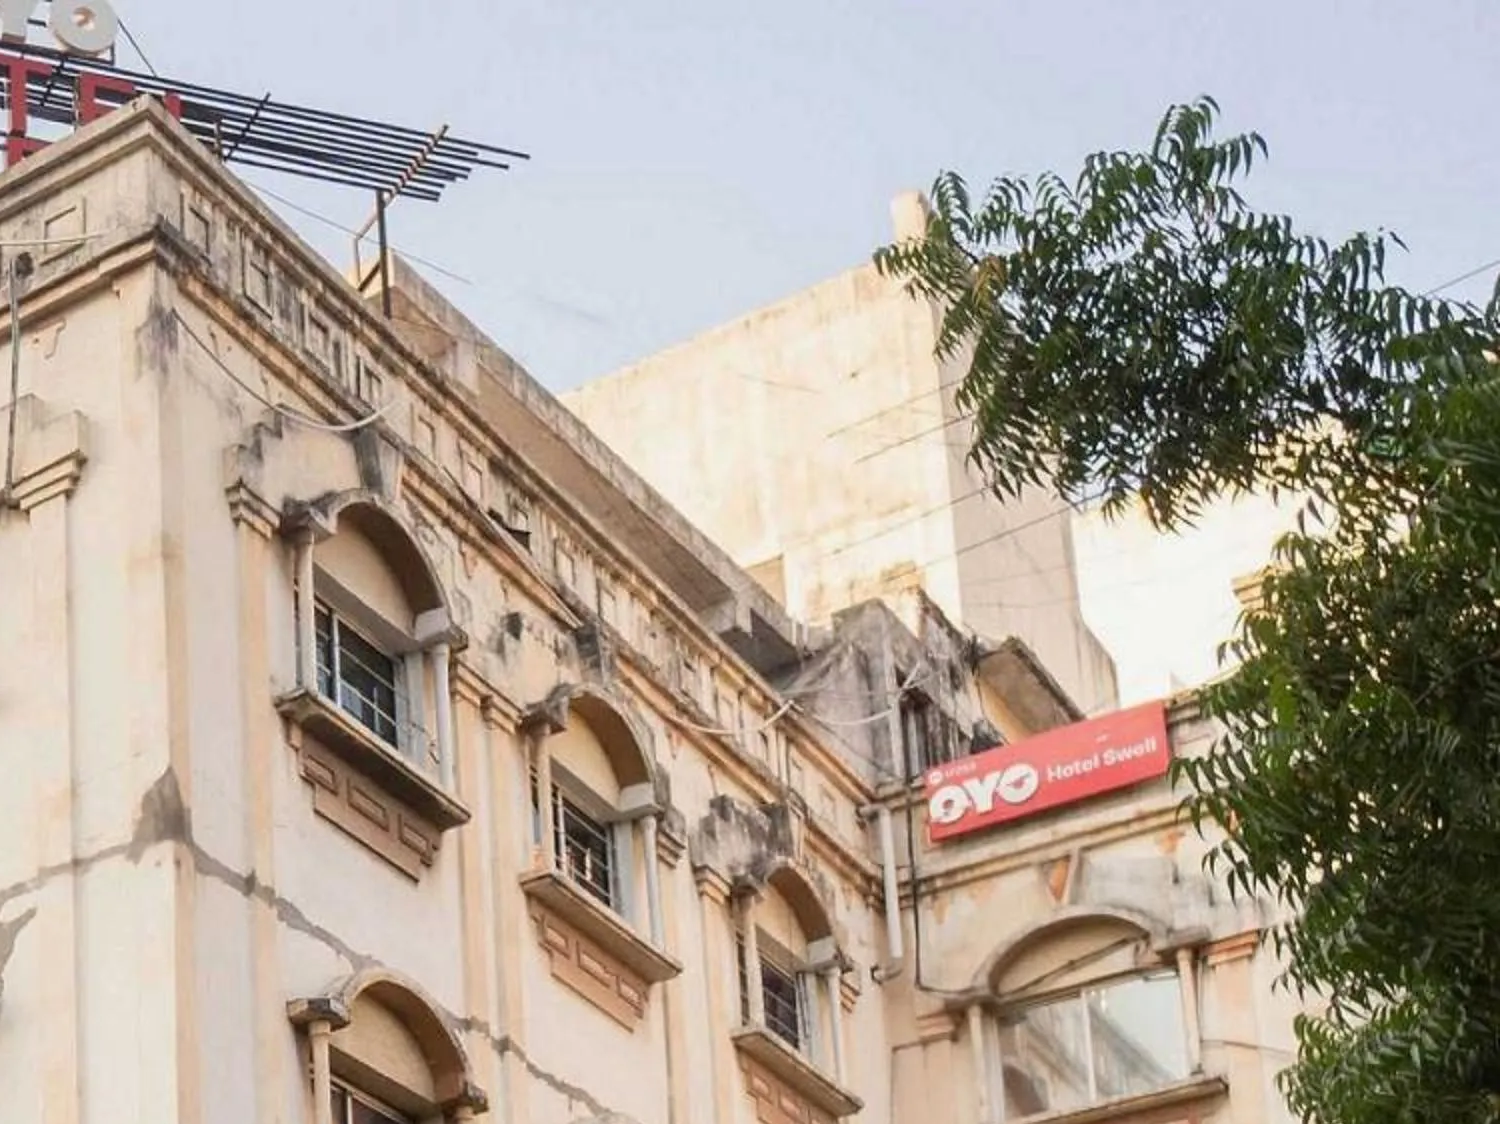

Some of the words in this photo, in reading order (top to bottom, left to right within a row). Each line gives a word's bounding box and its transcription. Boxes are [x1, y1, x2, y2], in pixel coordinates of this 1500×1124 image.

[929, 762, 1039, 824] OYO
[1046, 754, 1101, 784] Hotel
[1102, 735, 1158, 767] Swell
